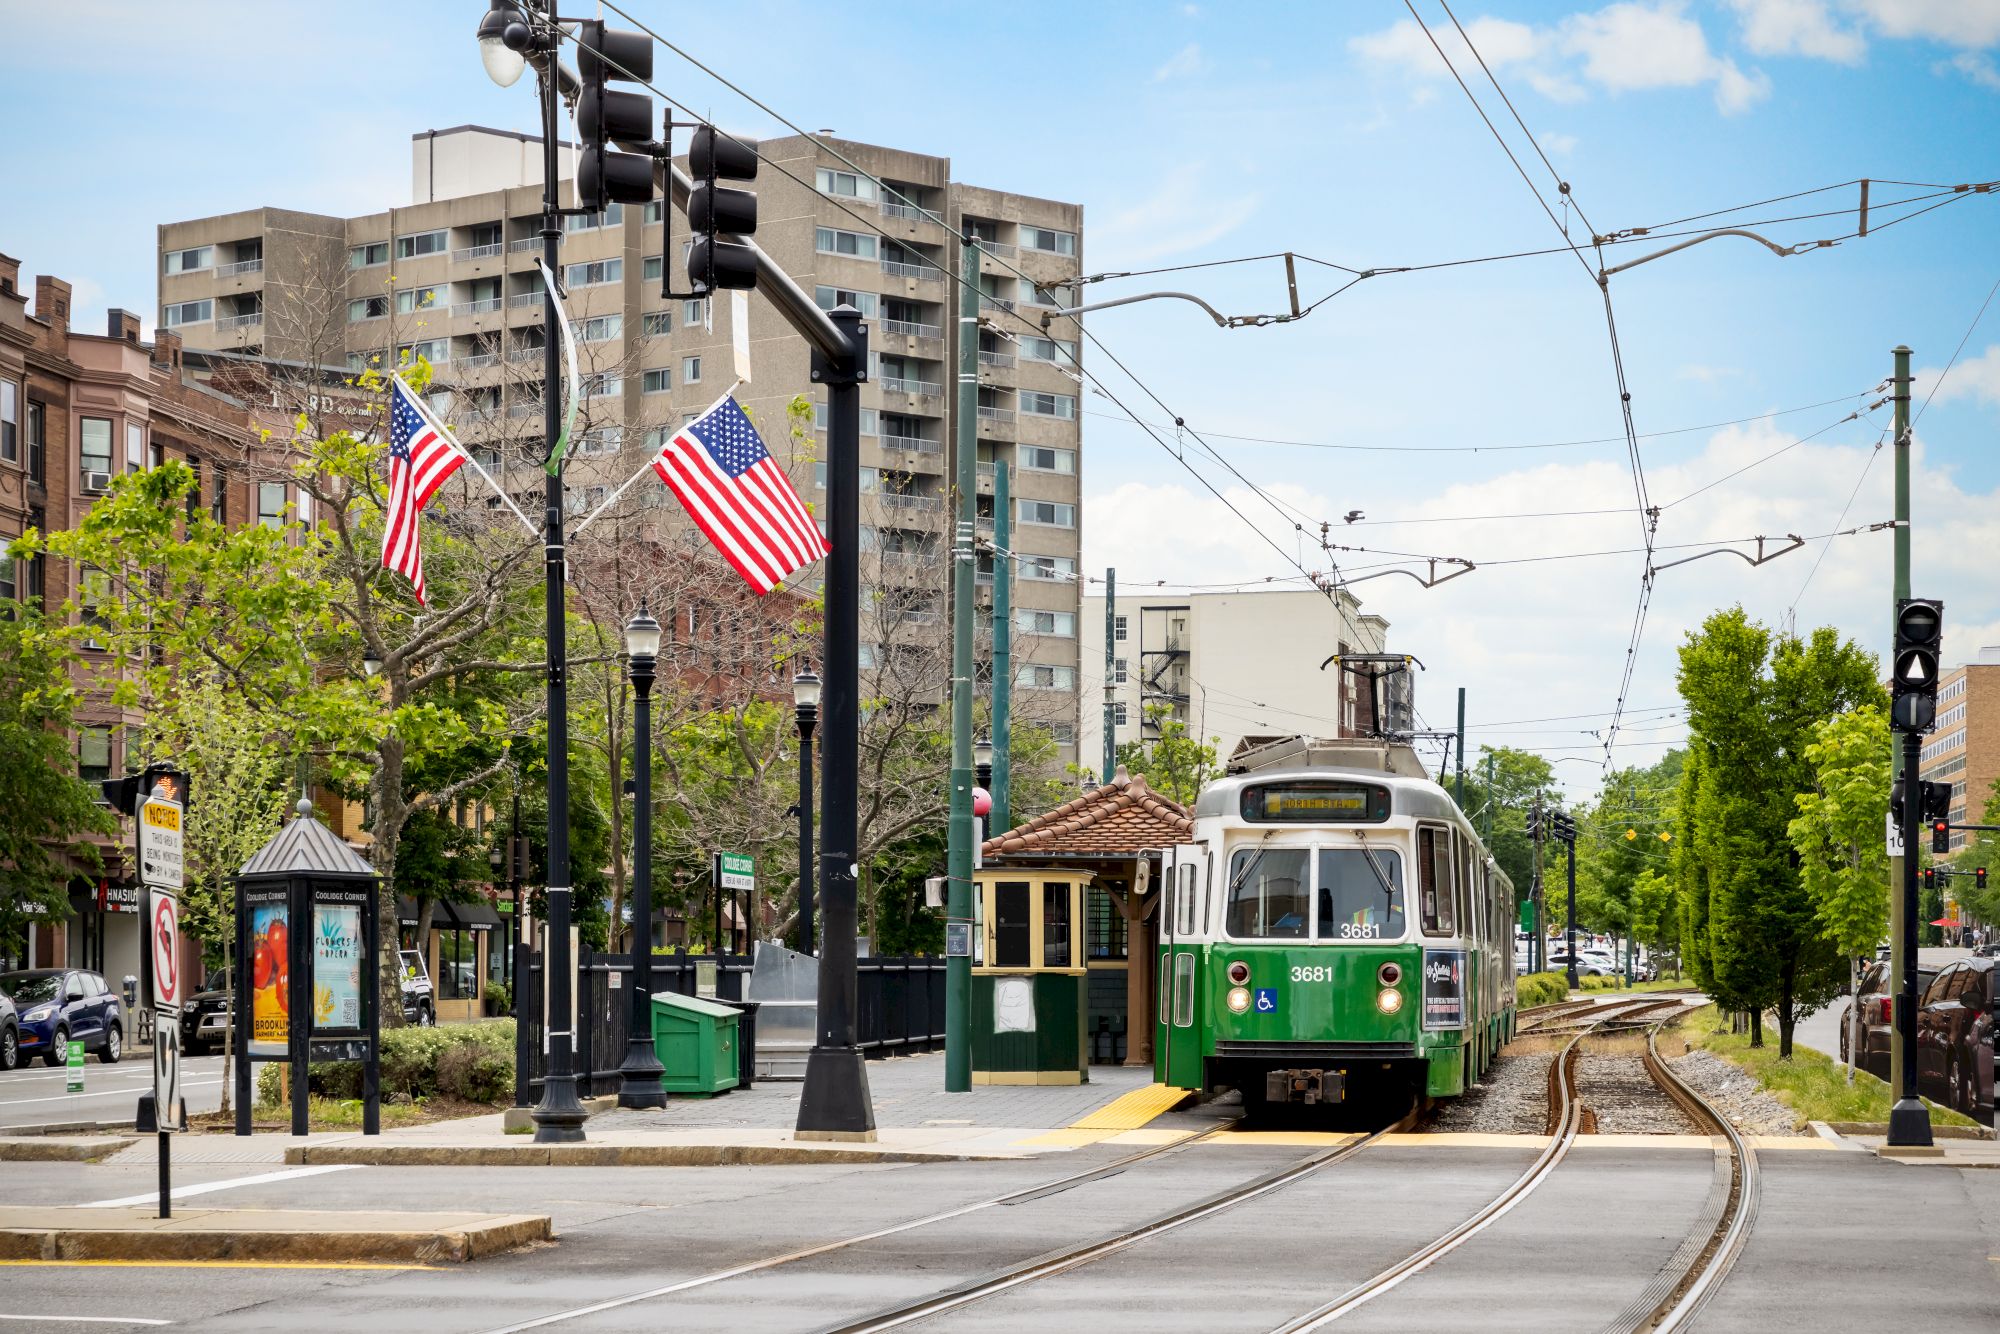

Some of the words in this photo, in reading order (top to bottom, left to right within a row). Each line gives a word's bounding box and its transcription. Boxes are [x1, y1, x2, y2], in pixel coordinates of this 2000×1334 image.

[149, 806, 176, 828] NOTICE
[247, 893, 268, 901] COOLIDGE
[268, 892, 287, 900] CORNER
[315, 891, 343, 900] COOLIDGE
[344, 892, 367, 900] CORNER
[1341, 923, 1380, 939] 3681
[315, 937, 351, 947] FLOWERS
[1291, 966, 1332, 982] 3681
